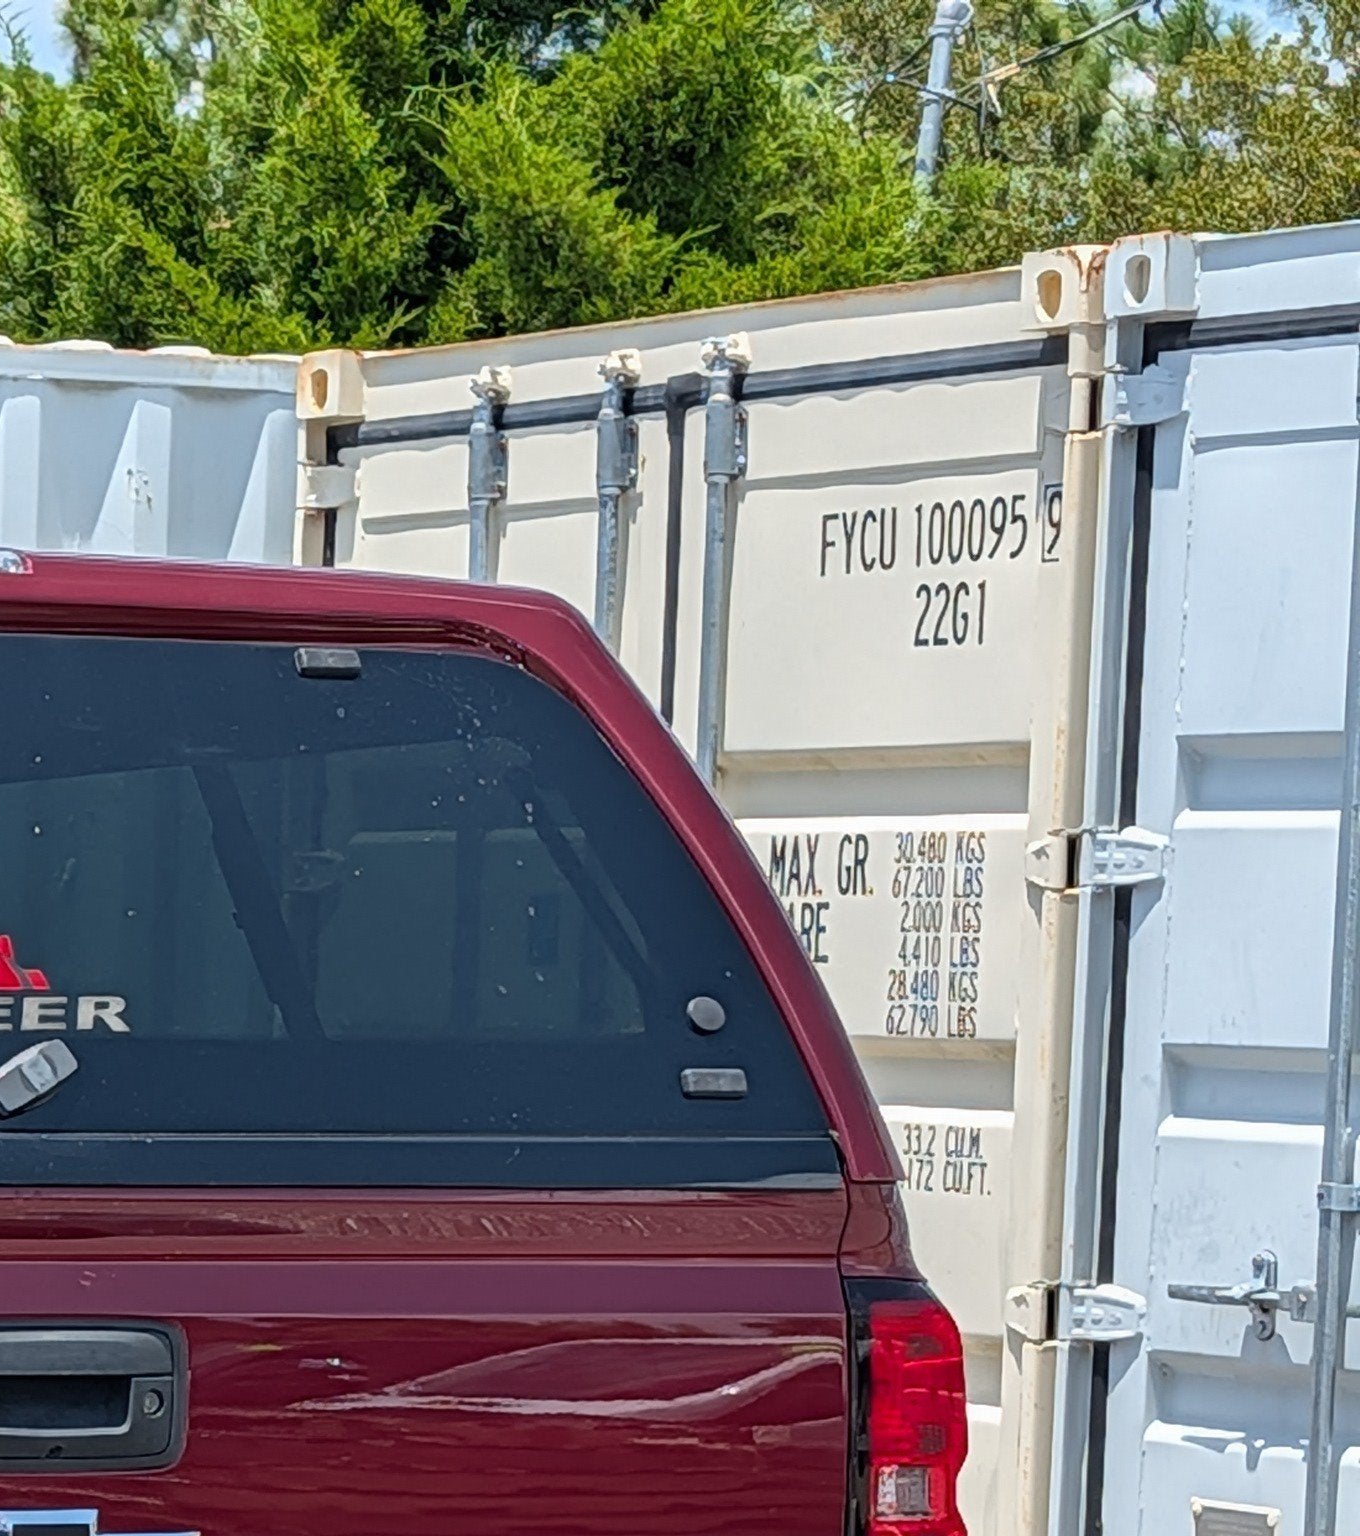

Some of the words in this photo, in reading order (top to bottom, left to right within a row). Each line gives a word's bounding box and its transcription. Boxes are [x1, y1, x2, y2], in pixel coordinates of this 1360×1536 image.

[820, 506, 898, 577] FYCU
[914, 494, 1029, 568] 100095
[913, 579, 988, 648] 22G1
[837, 833, 875, 897] GR.
[955, 831, 986, 864] KGS
[953, 866, 985, 899] LBS
[950, 901, 983, 934] KGS
[949, 936, 980, 968] LBS
[947, 969, 979, 1003] KGS
[946, 1004, 978, 1038] LBS
